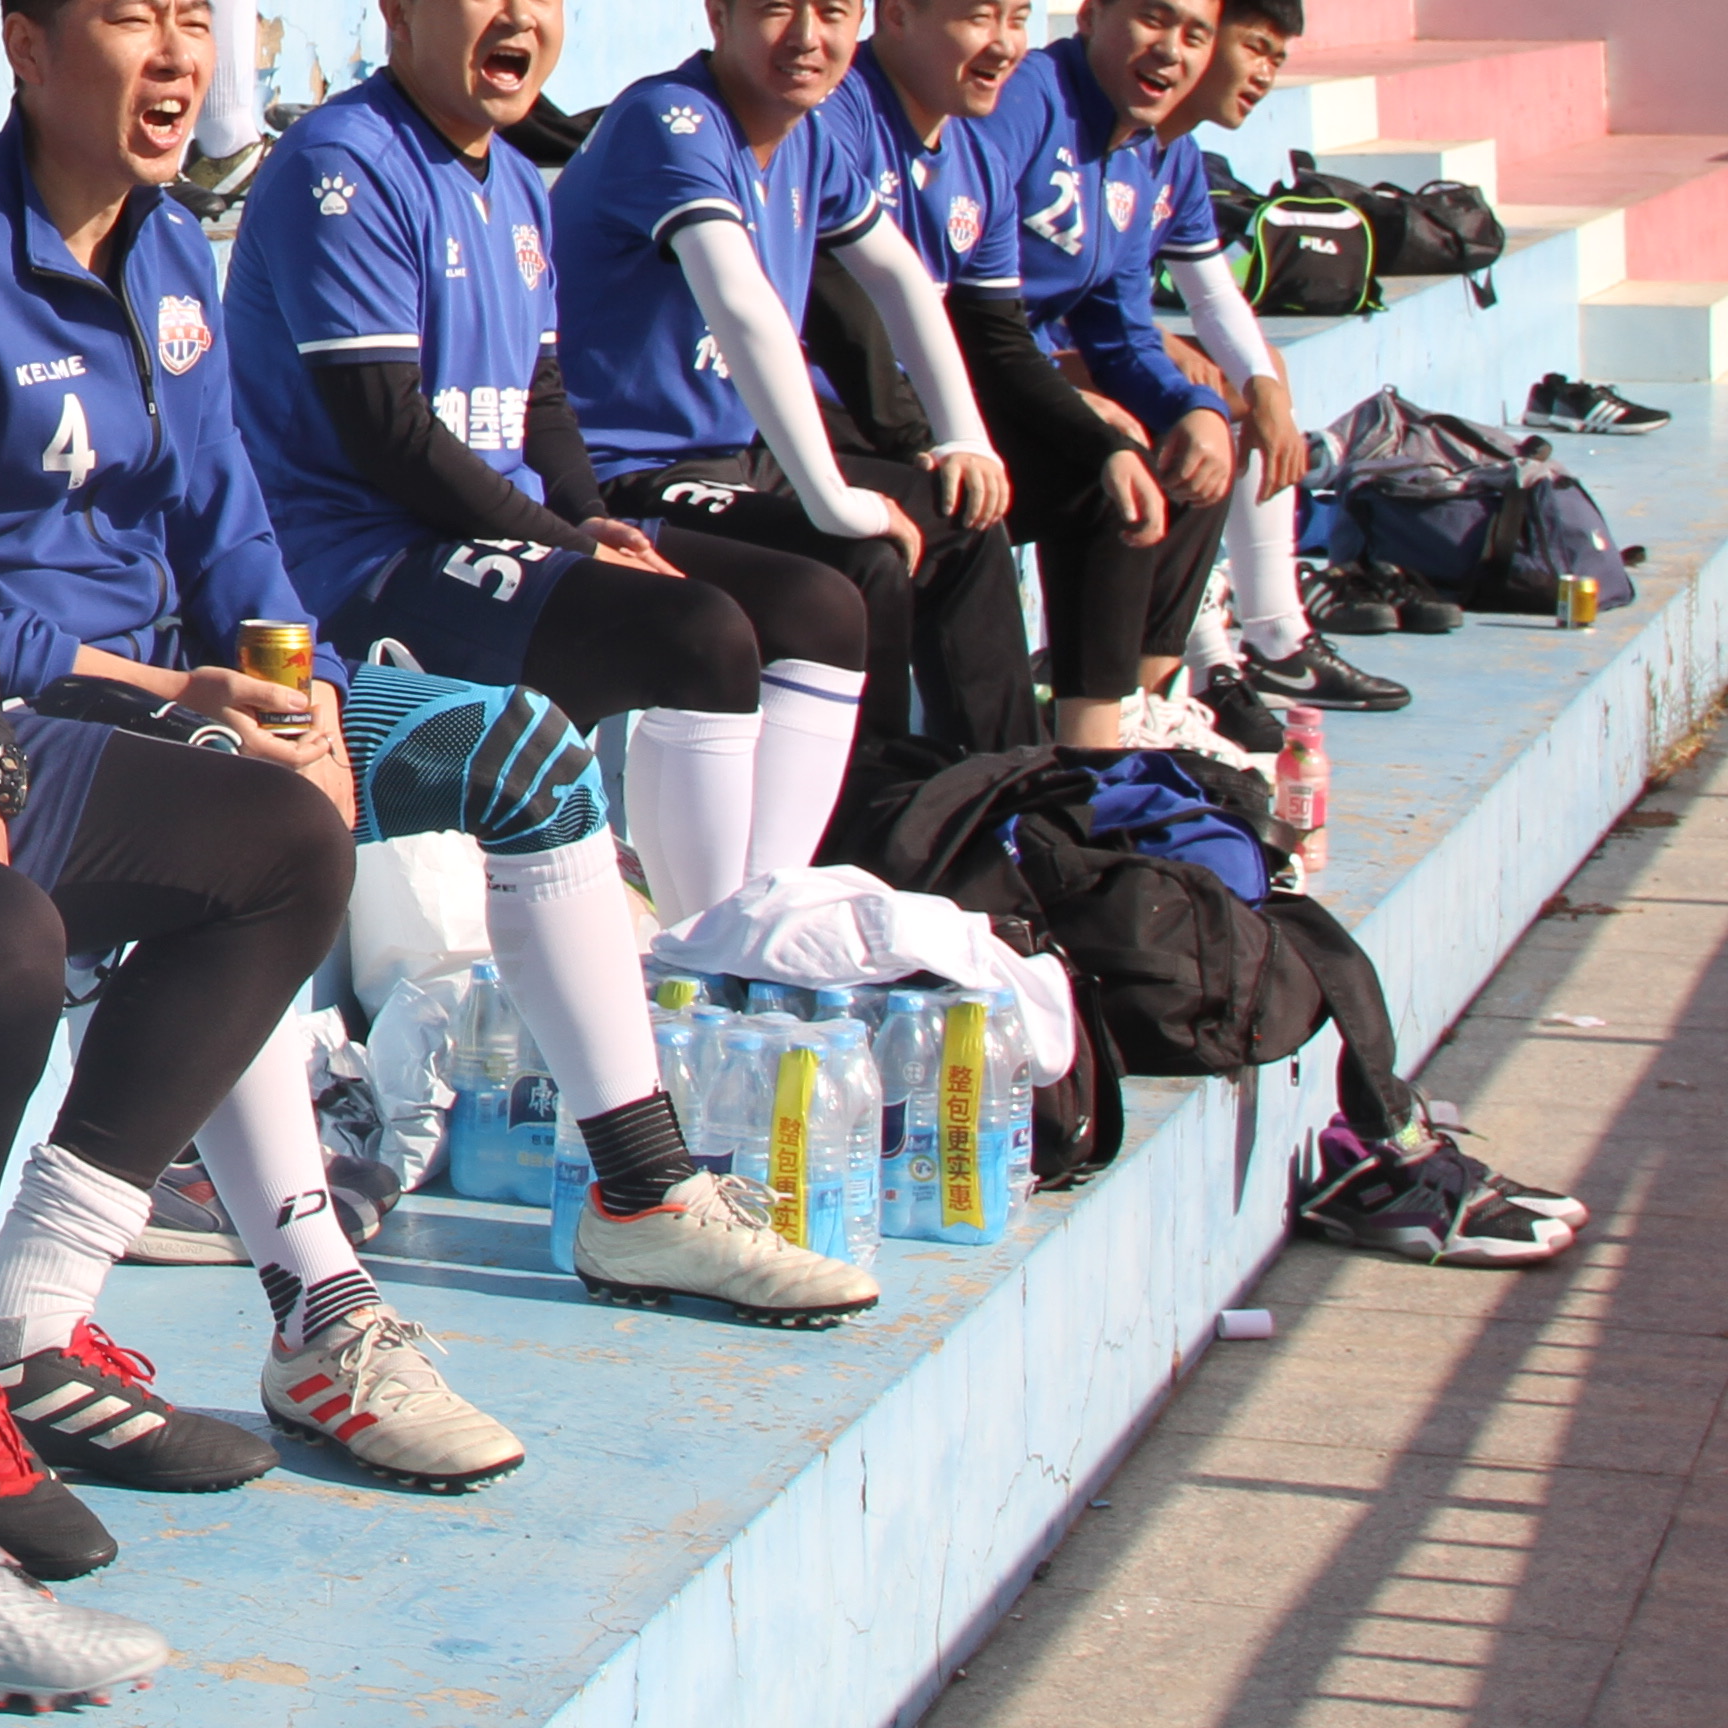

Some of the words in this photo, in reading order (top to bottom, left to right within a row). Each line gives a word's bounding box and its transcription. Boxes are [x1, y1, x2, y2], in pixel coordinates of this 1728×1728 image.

[1298, 234, 1342, 256] FILA
[17, 356, 87, 386] KELME
[42, 392, 97, 490] 4
[661, 479, 756, 514] 3
[1288, 797, 1310, 815] 50
[945, 1065, 973, 1212] 整包更实惠
